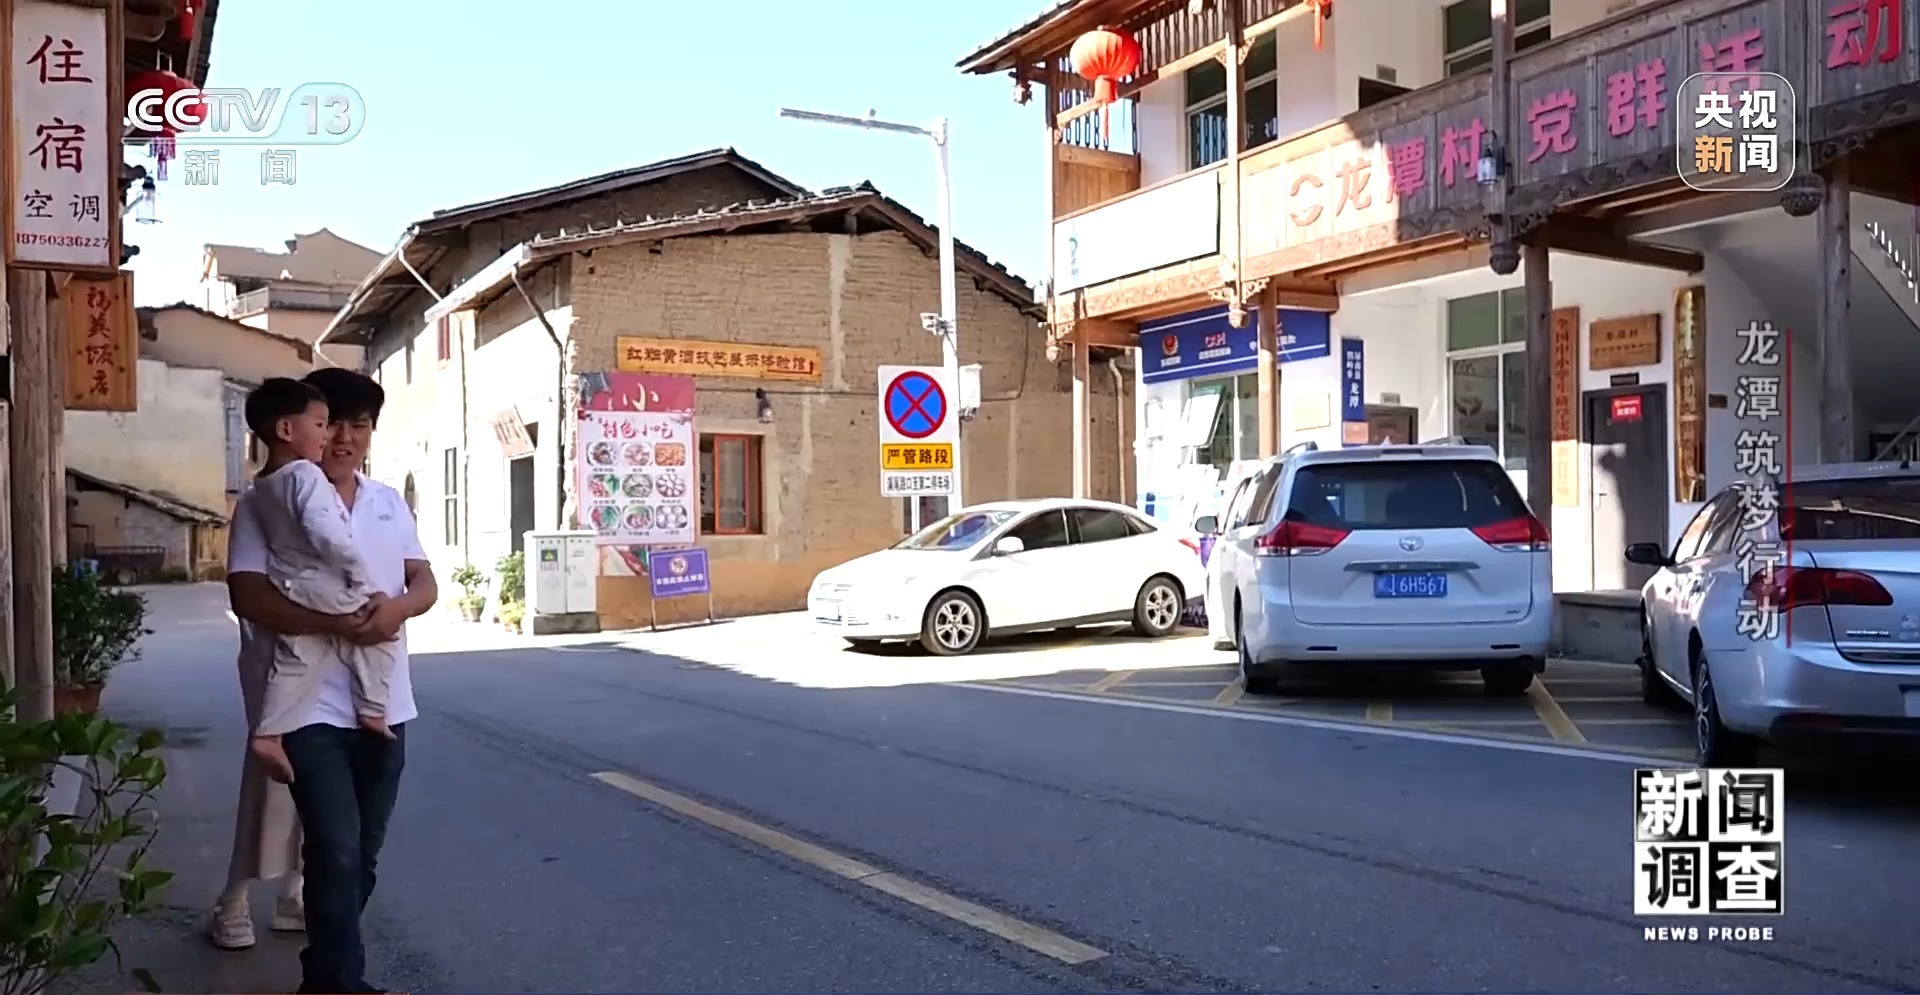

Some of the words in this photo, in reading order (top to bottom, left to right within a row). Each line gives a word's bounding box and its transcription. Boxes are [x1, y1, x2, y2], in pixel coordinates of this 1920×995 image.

[26, 34, 93, 174] 住宿
[24, 189, 100, 222] 空调
[16, 233, 110, 249] 18750336227
[886, 447, 949, 465] 严管路段
